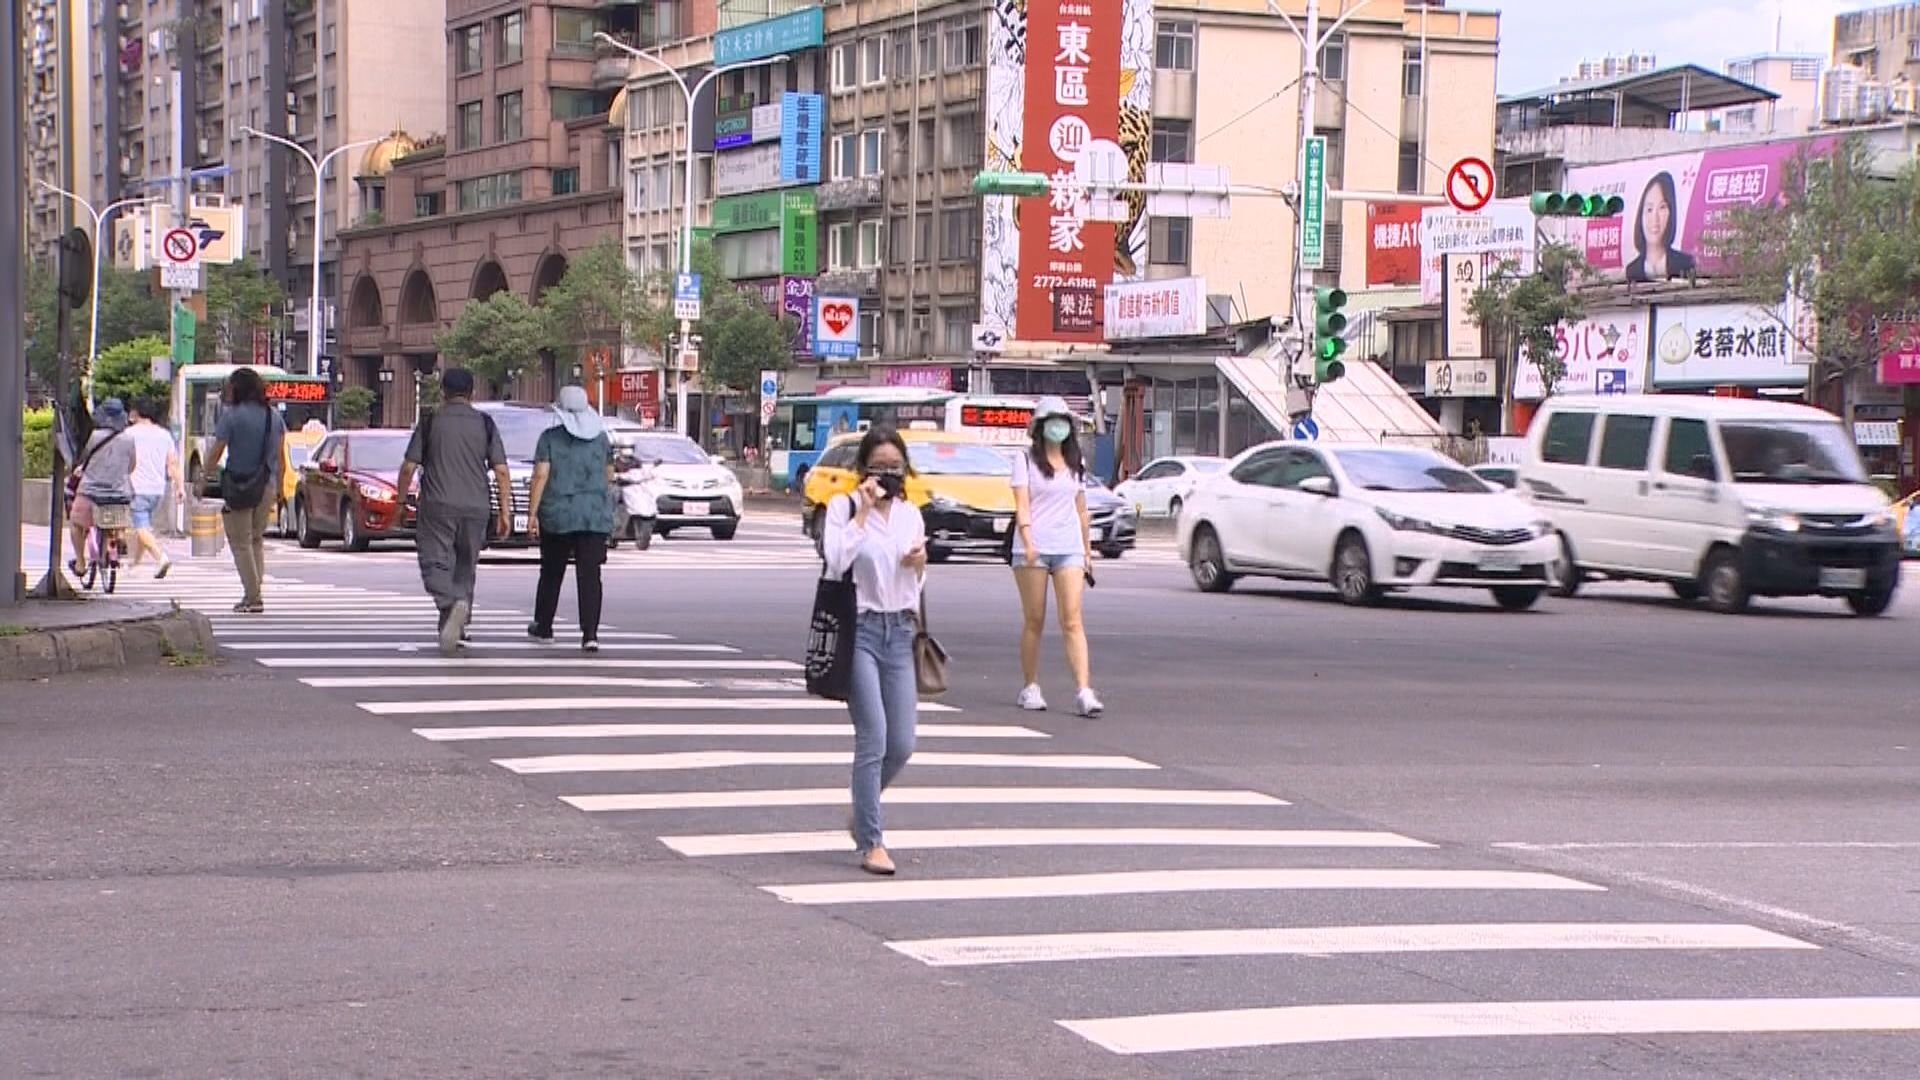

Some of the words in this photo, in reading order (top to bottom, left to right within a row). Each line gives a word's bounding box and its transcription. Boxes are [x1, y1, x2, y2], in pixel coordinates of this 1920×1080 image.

[1711, 172, 1762, 198] 聯絡站
[678, 274, 692, 291] P
[1060, 292, 1094, 317] 樂法
[622, 374, 649, 390] GNC
[1598, 370, 1614, 390] P
